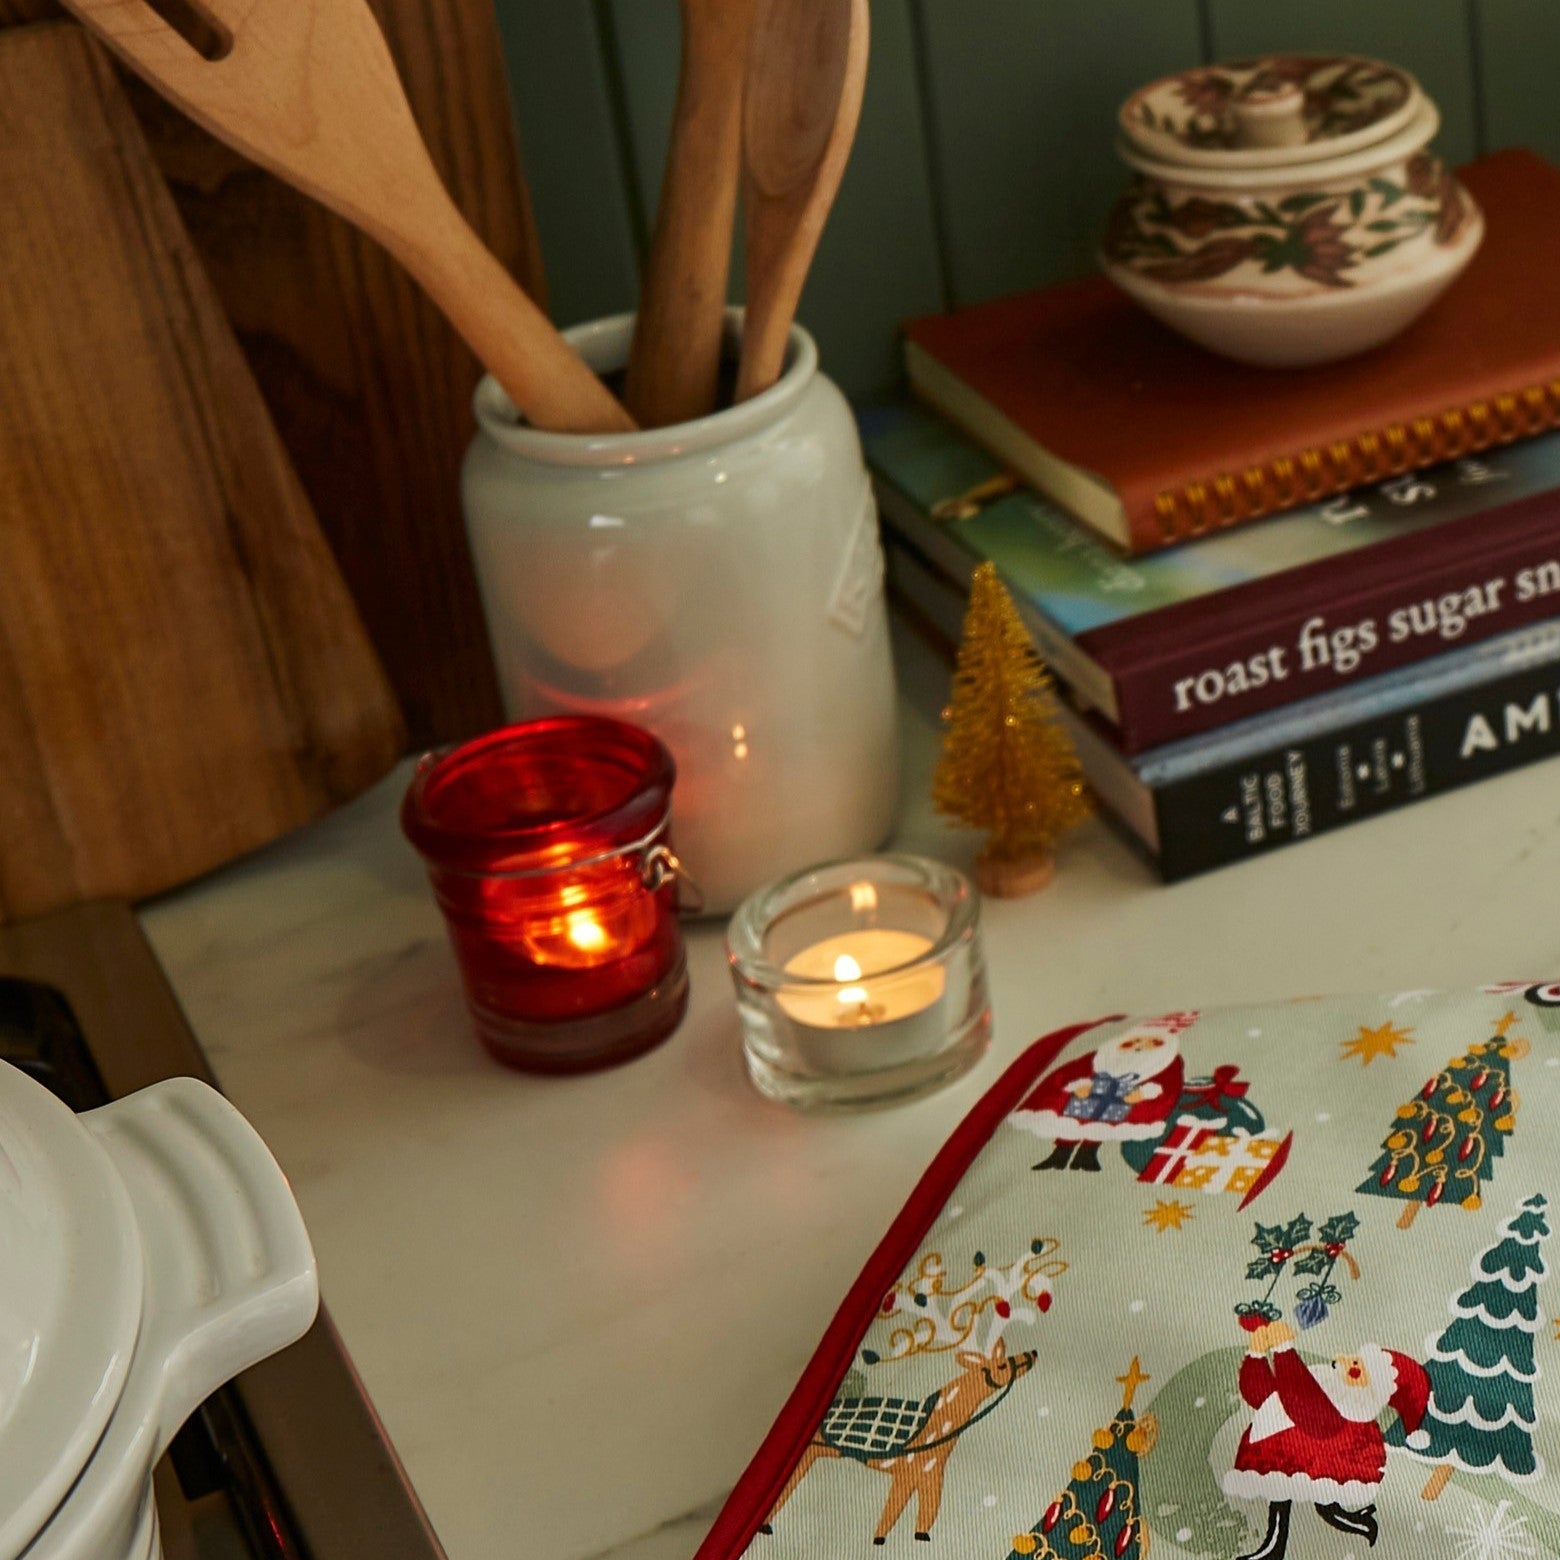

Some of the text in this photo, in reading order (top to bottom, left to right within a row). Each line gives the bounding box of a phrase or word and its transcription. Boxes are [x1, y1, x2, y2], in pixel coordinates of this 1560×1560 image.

[1173, 646, 1288, 711] roast
[1299, 617, 1378, 673] figs
[1387, 576, 1505, 639] sugar
[1221, 806, 1239, 823] A
[1241, 773, 1265, 842] BALTIC
[1265, 773, 1286, 829] FOOD
[1286, 751, 1311, 836] JOURNEY
